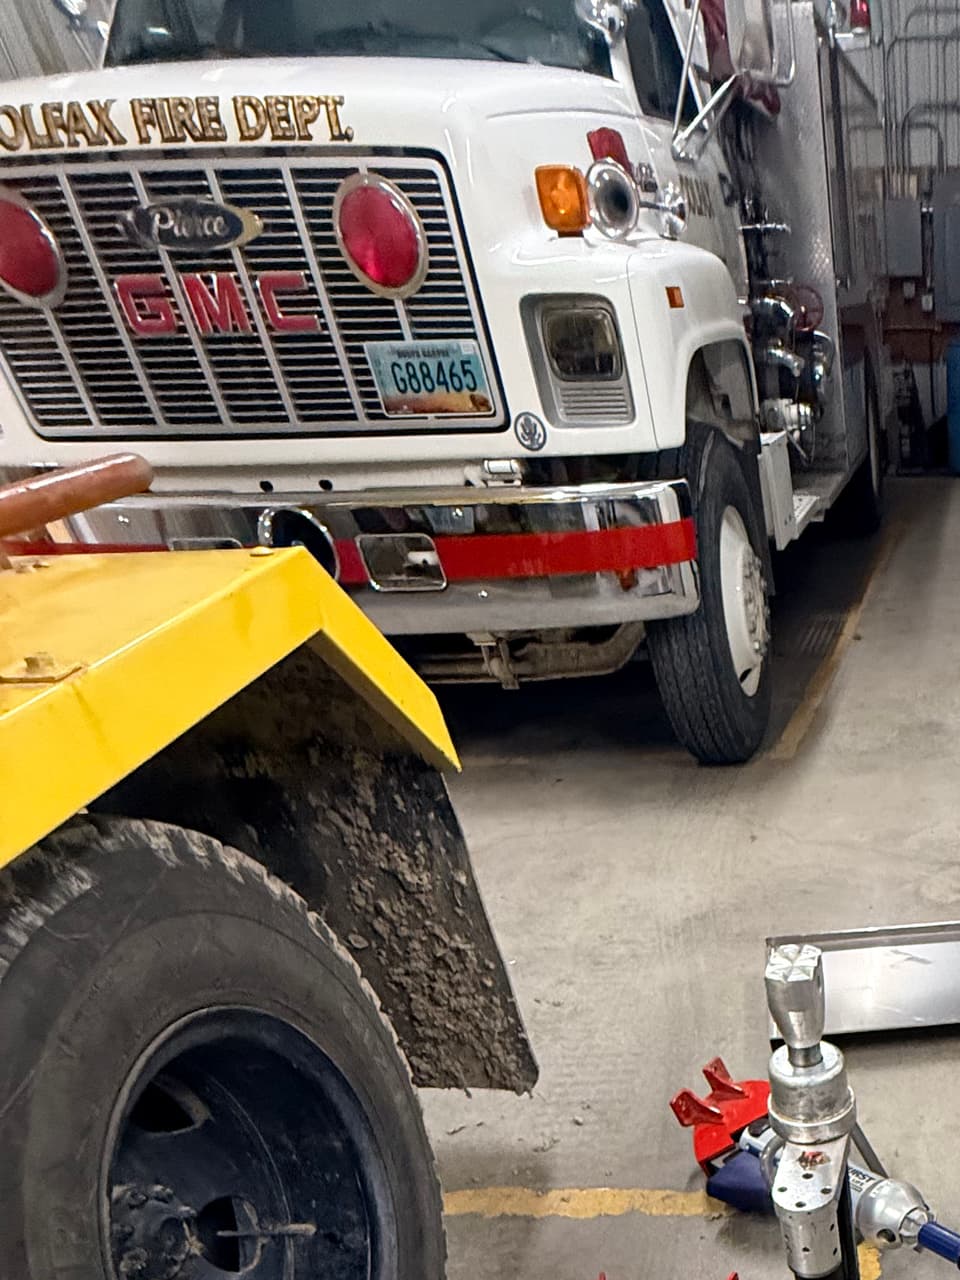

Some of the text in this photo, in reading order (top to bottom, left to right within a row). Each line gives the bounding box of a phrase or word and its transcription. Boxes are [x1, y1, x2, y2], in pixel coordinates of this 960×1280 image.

[130, 96, 228, 145] FIRE
[232, 95, 355, 142] DEPT.
[114, 270, 321, 336] GMC
[391, 360, 477, 393] G88465
